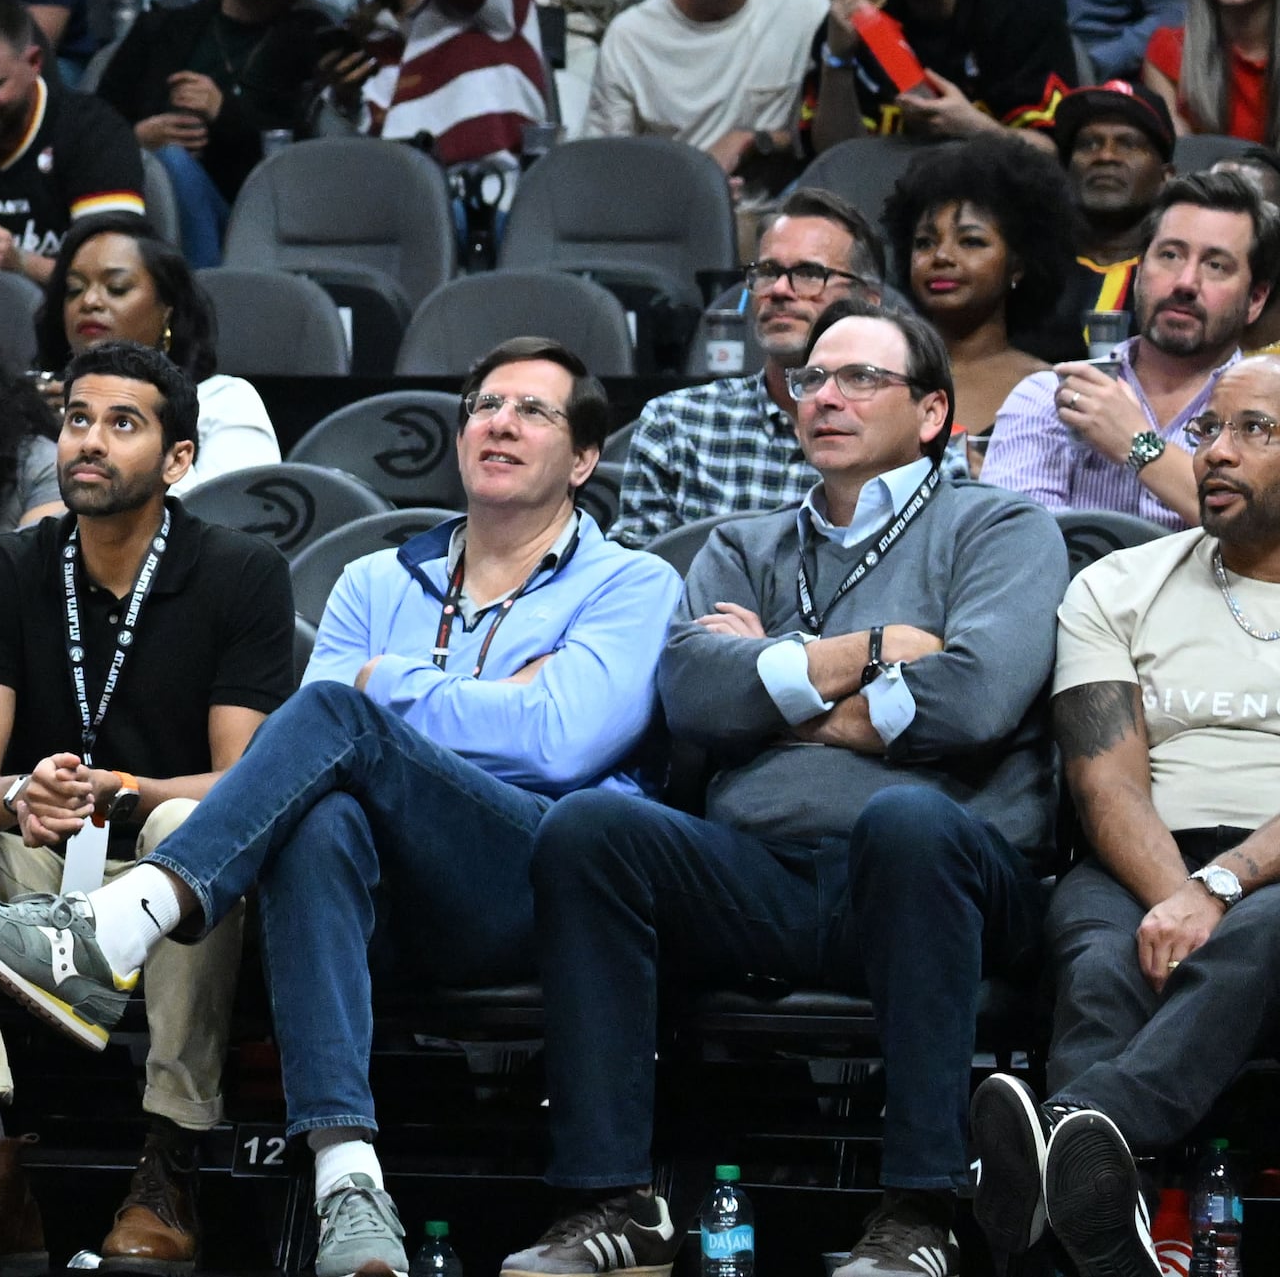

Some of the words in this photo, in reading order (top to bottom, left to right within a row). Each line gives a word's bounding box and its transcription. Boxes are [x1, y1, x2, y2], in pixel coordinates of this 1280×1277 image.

[878, 518, 906, 553] ATLANTA
[903, 495, 925, 522] HAWKS
[1142, 685, 1280, 718] GIVEN
[243, 1135, 287, 1165] 12
[709, 1232, 753, 1253] DASANI
